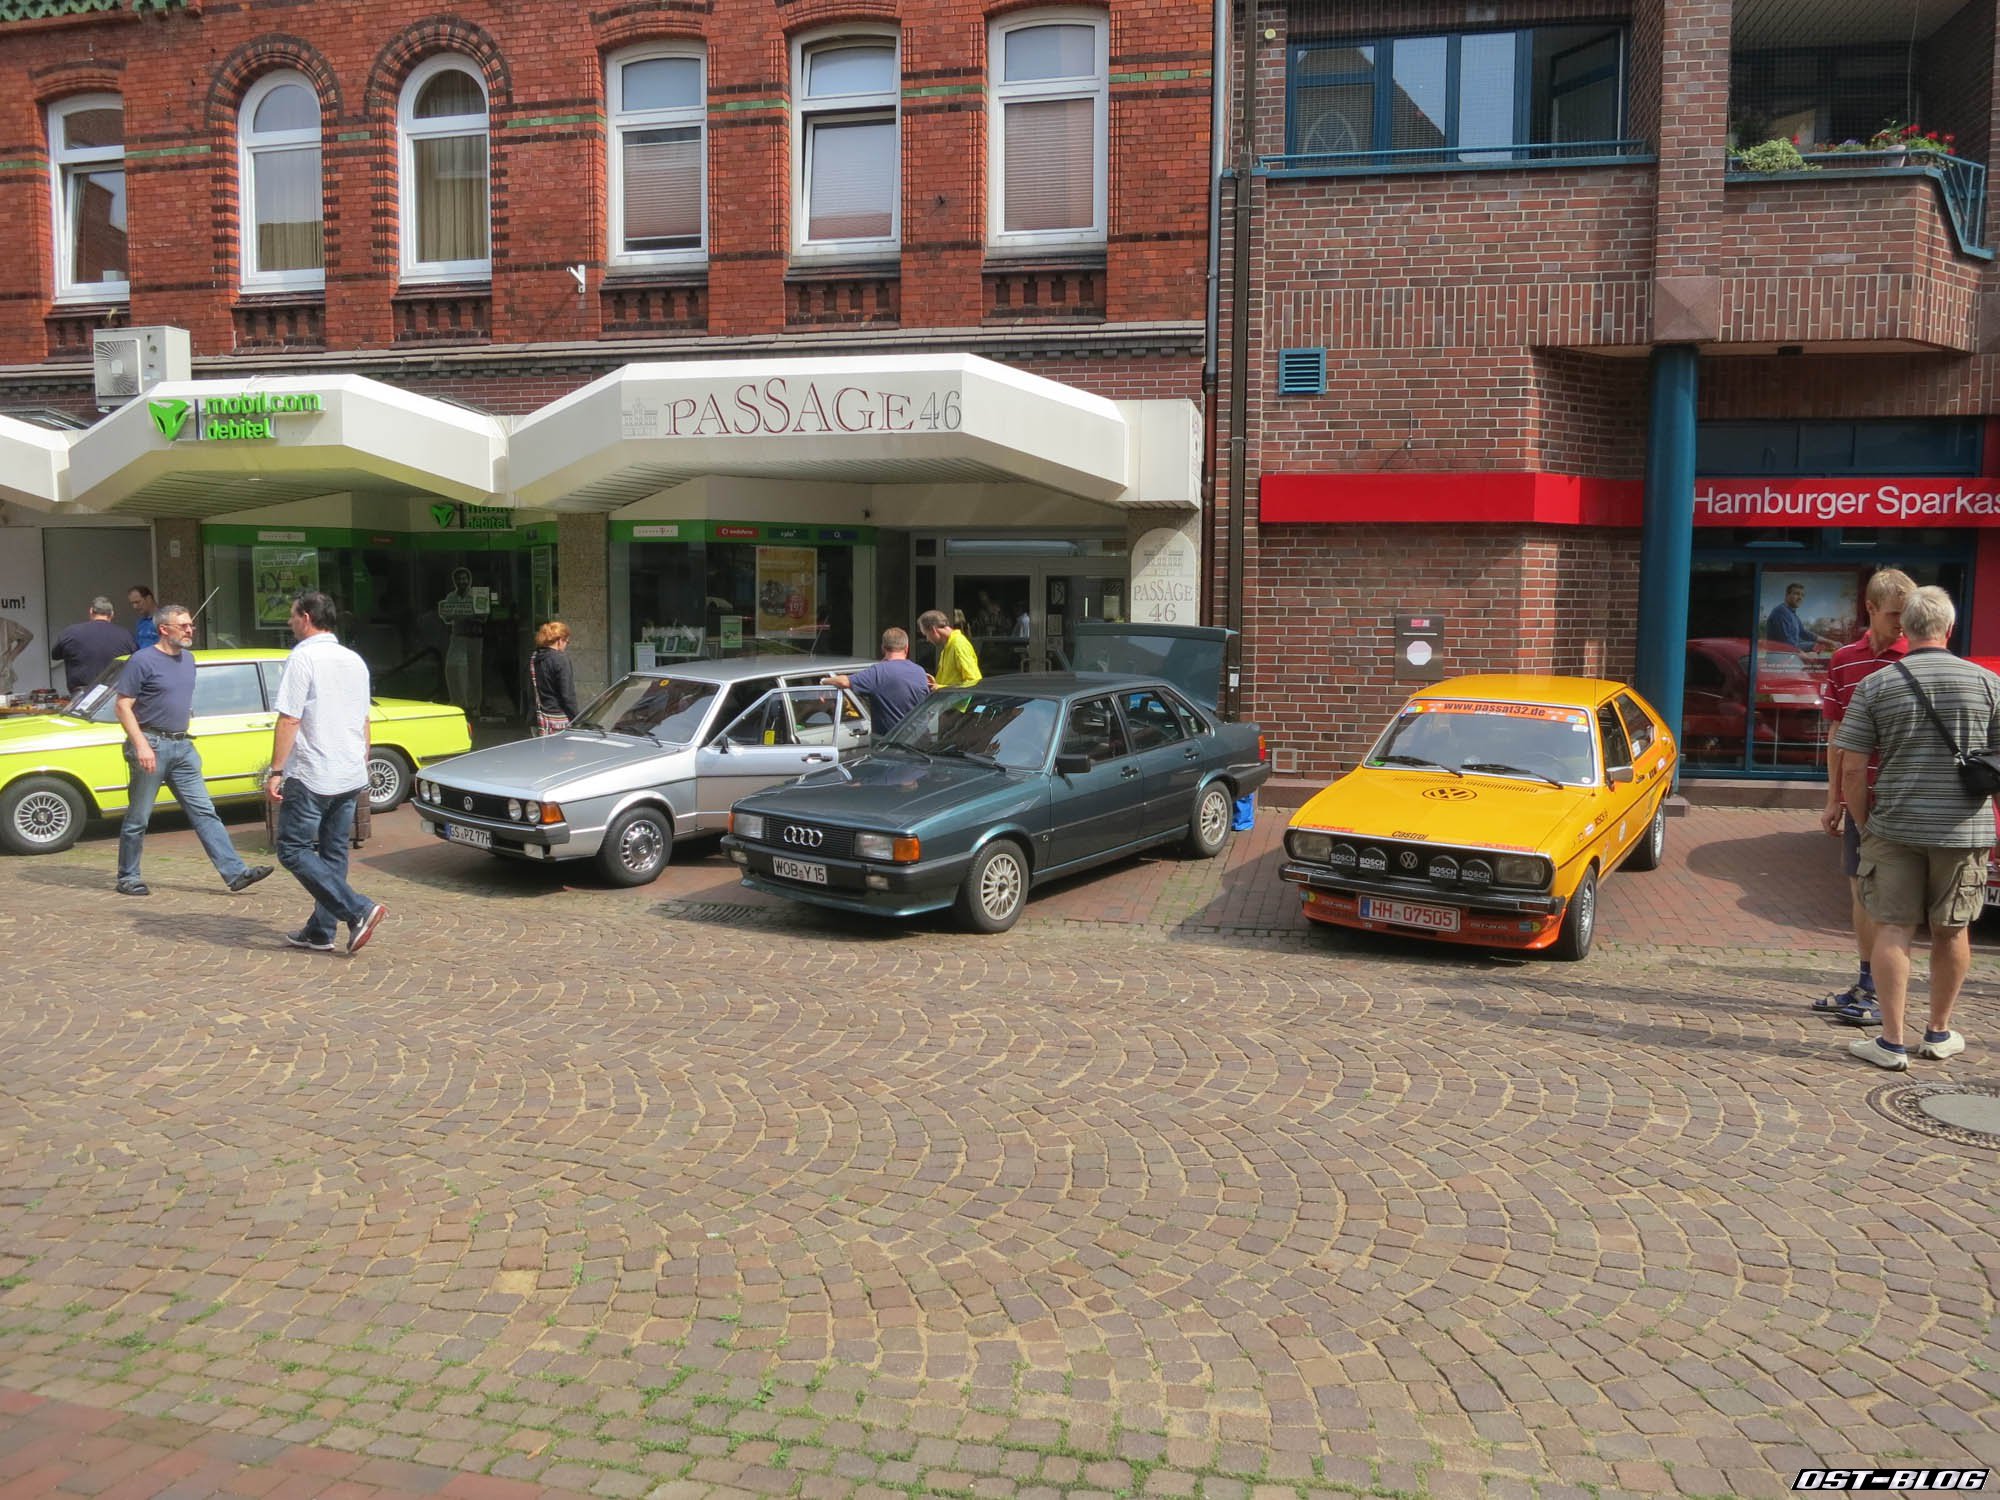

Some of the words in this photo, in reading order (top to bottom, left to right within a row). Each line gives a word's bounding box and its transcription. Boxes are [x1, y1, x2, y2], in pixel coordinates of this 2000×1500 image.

[664, 376, 914, 436] PASSAGE
[919, 389, 963, 431] 46
[207, 418, 272, 440] debitel
[1692, 486, 1871, 519] Hamburger
[1133, 579, 1194, 601] PASSAGE
[1149, 602, 1177, 623] 46
[1443, 702, 1547, 717] www.passat32.de
[1392, 830, 1429, 841] Castrol
[1330, 852, 1357, 864] BOSCH
[1359, 857, 1386, 868] BOSCH
[814, 867, 825, 882] 15
[1429, 865, 1458, 875] BOSCH
[1461, 869, 1491, 880] BOSCH
[1372, 901, 1393, 919] HH
[1403, 905, 1453, 927] 07505
